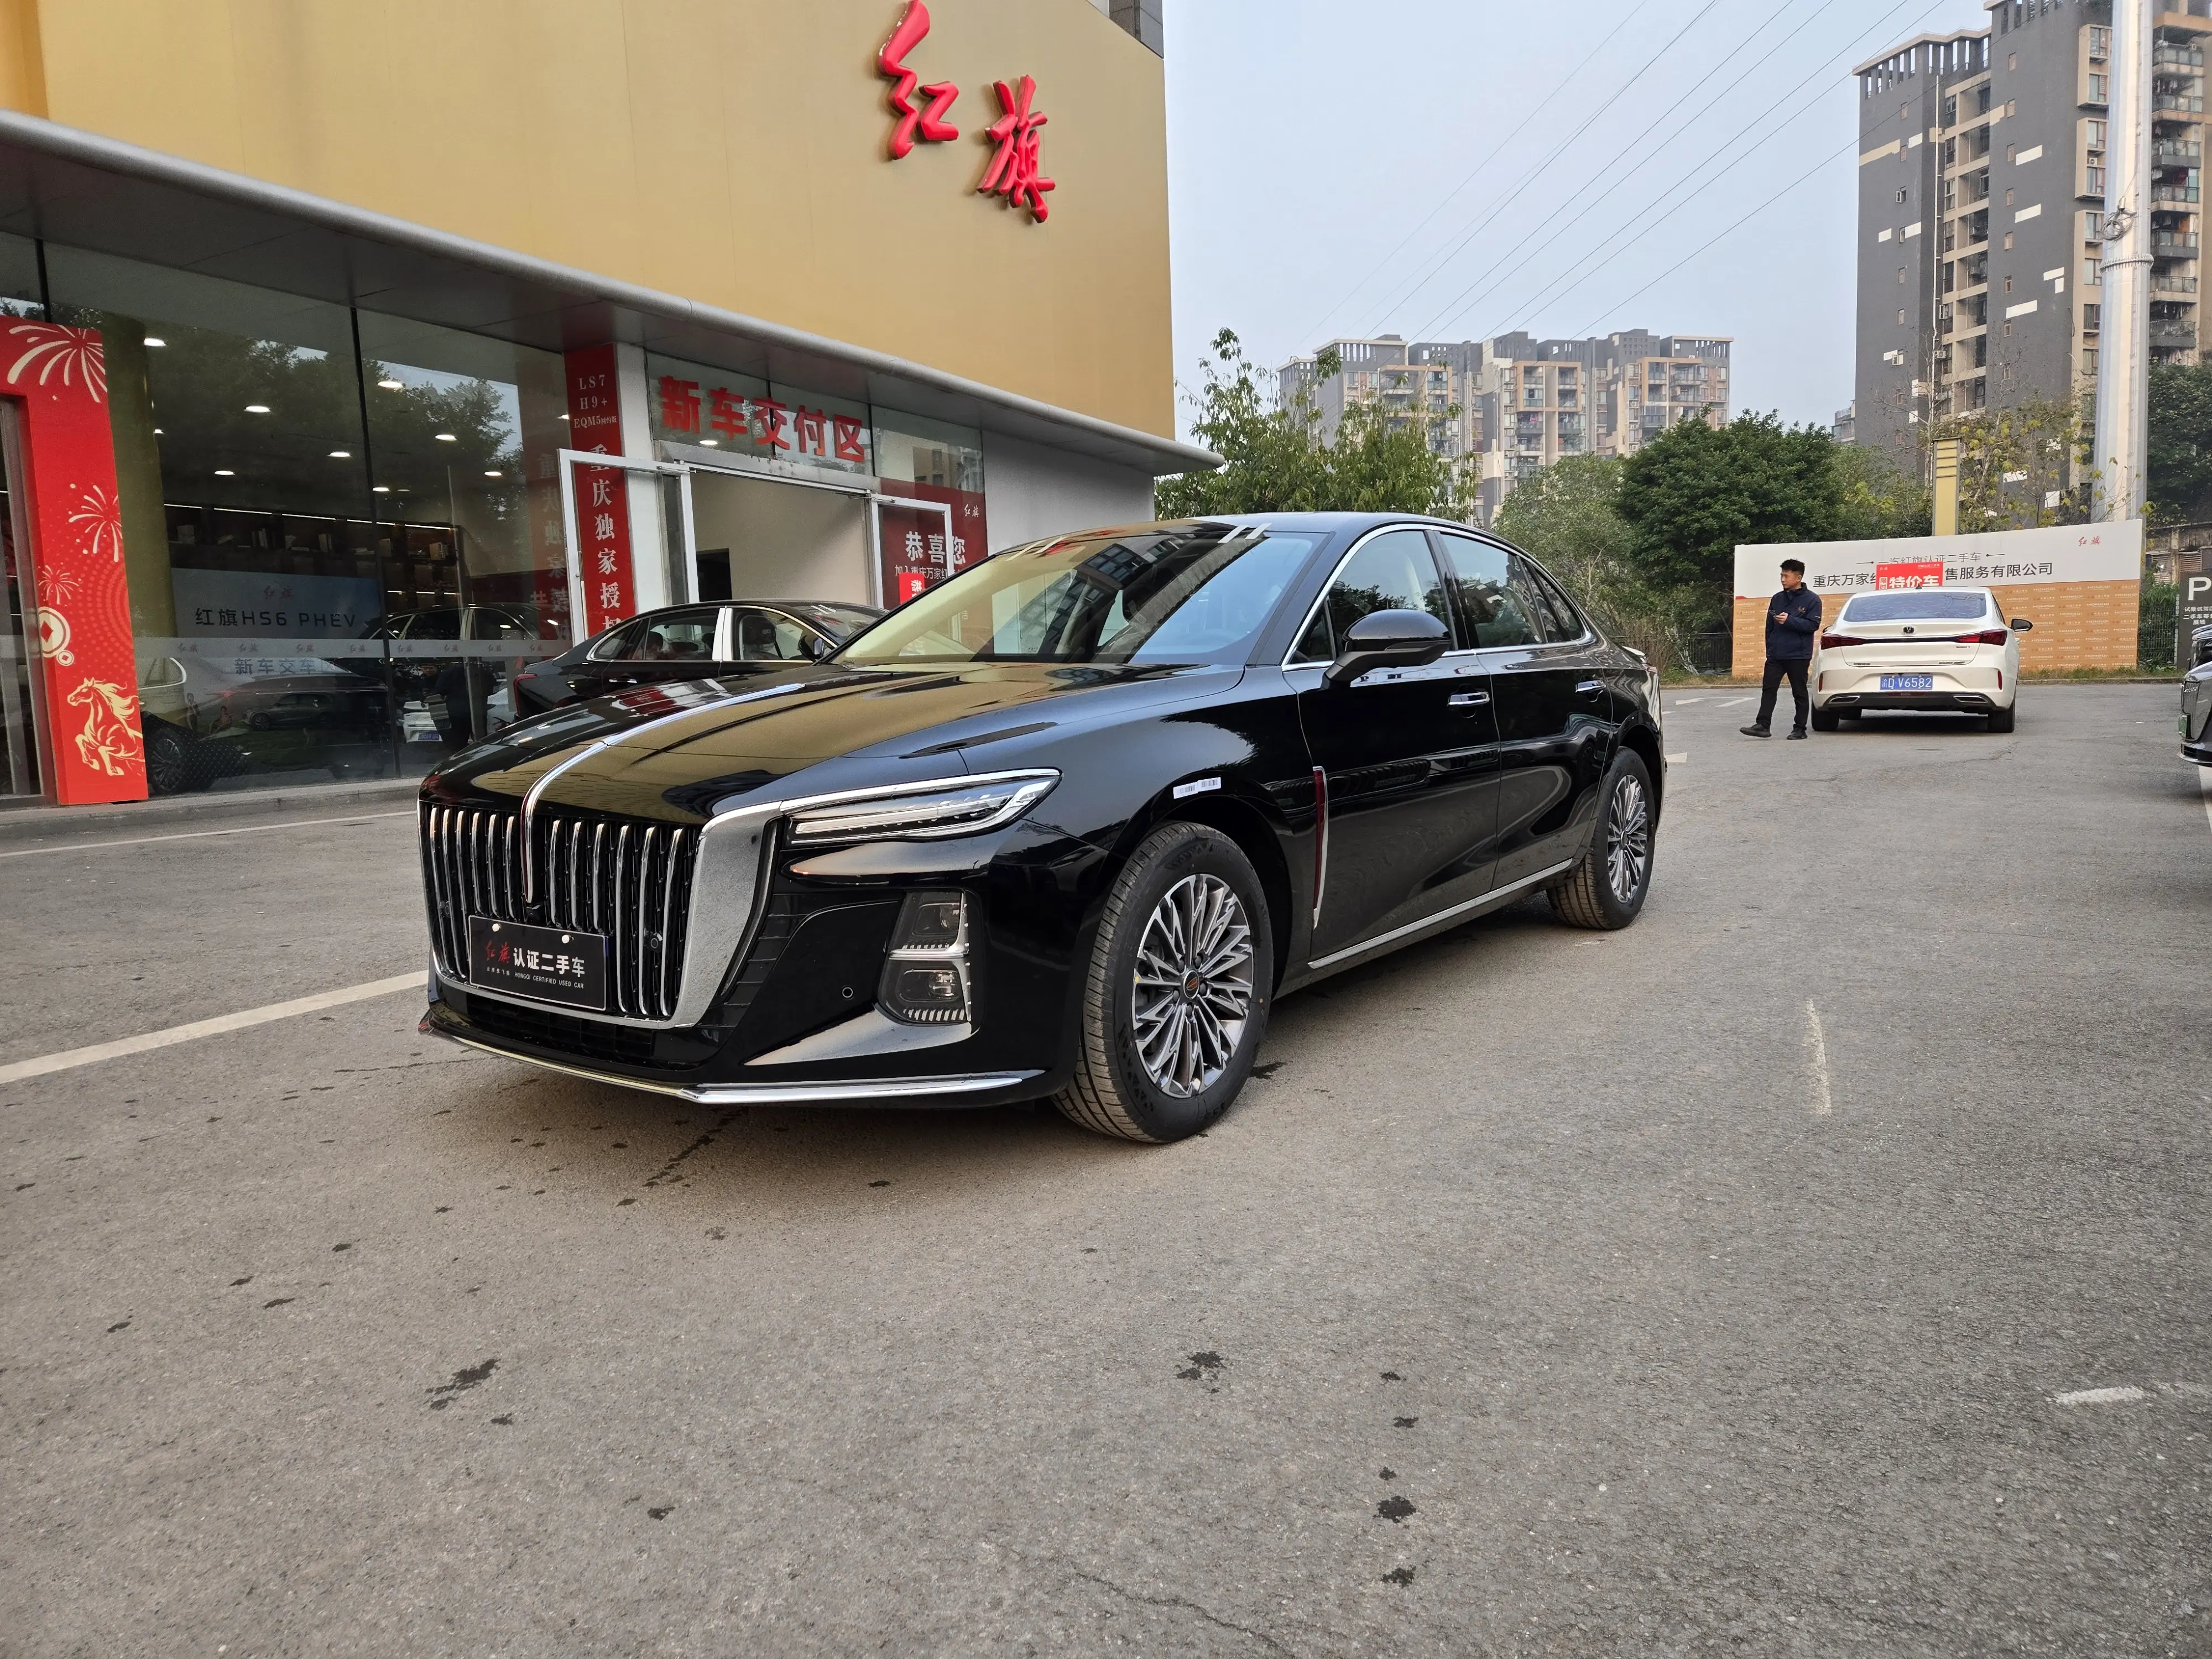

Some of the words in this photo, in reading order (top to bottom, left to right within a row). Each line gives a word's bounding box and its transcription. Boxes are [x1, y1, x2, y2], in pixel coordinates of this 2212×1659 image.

[878, 0, 1056, 223] 红旗
[579, 374, 605, 390] LS7
[580, 395, 608, 410] H9+
[659, 375, 865, 463] 新车交付区
[964, 504, 979, 518] 红旗
[905, 531, 966, 565] 恭喜您
[2078, 535, 2101, 546] 红旗
[1889, 575, 1939, 589] 特价车
[2188, 577, 2212, 601] P
[196, 608, 288, 627] 红旗HS6
[299, 613, 356, 627] PHEV
[514, 972, 531, 980] HONGQI
[533, 975, 556, 985] CERTIFIED
